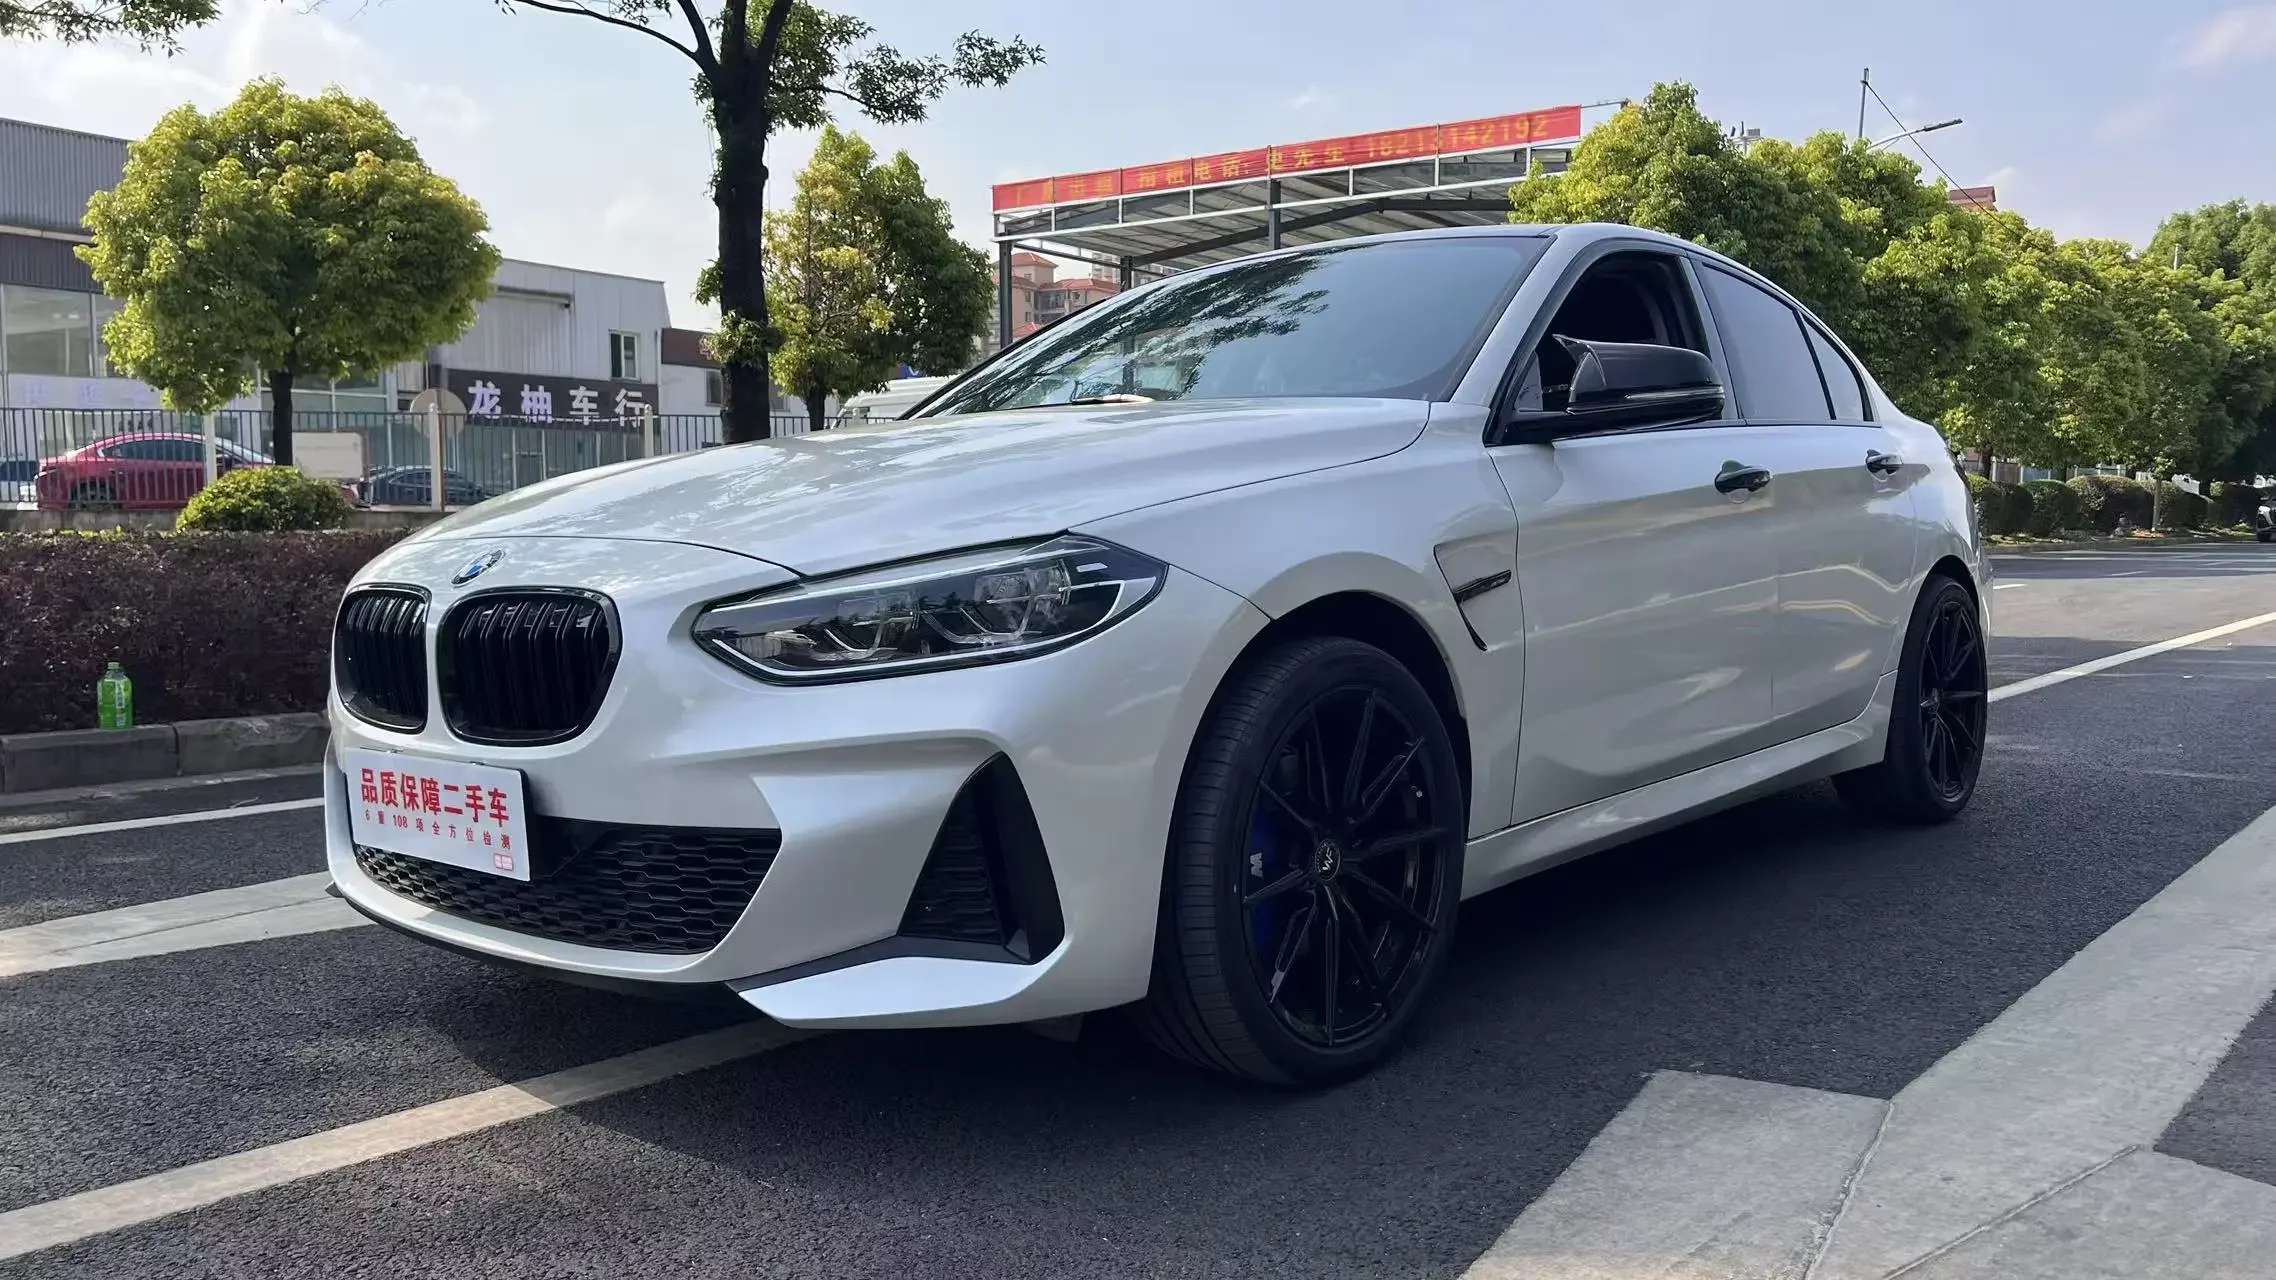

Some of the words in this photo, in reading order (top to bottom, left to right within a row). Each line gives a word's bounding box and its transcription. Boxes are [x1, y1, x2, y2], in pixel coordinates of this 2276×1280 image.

[361, 768, 509, 828] 品质保障二手车
